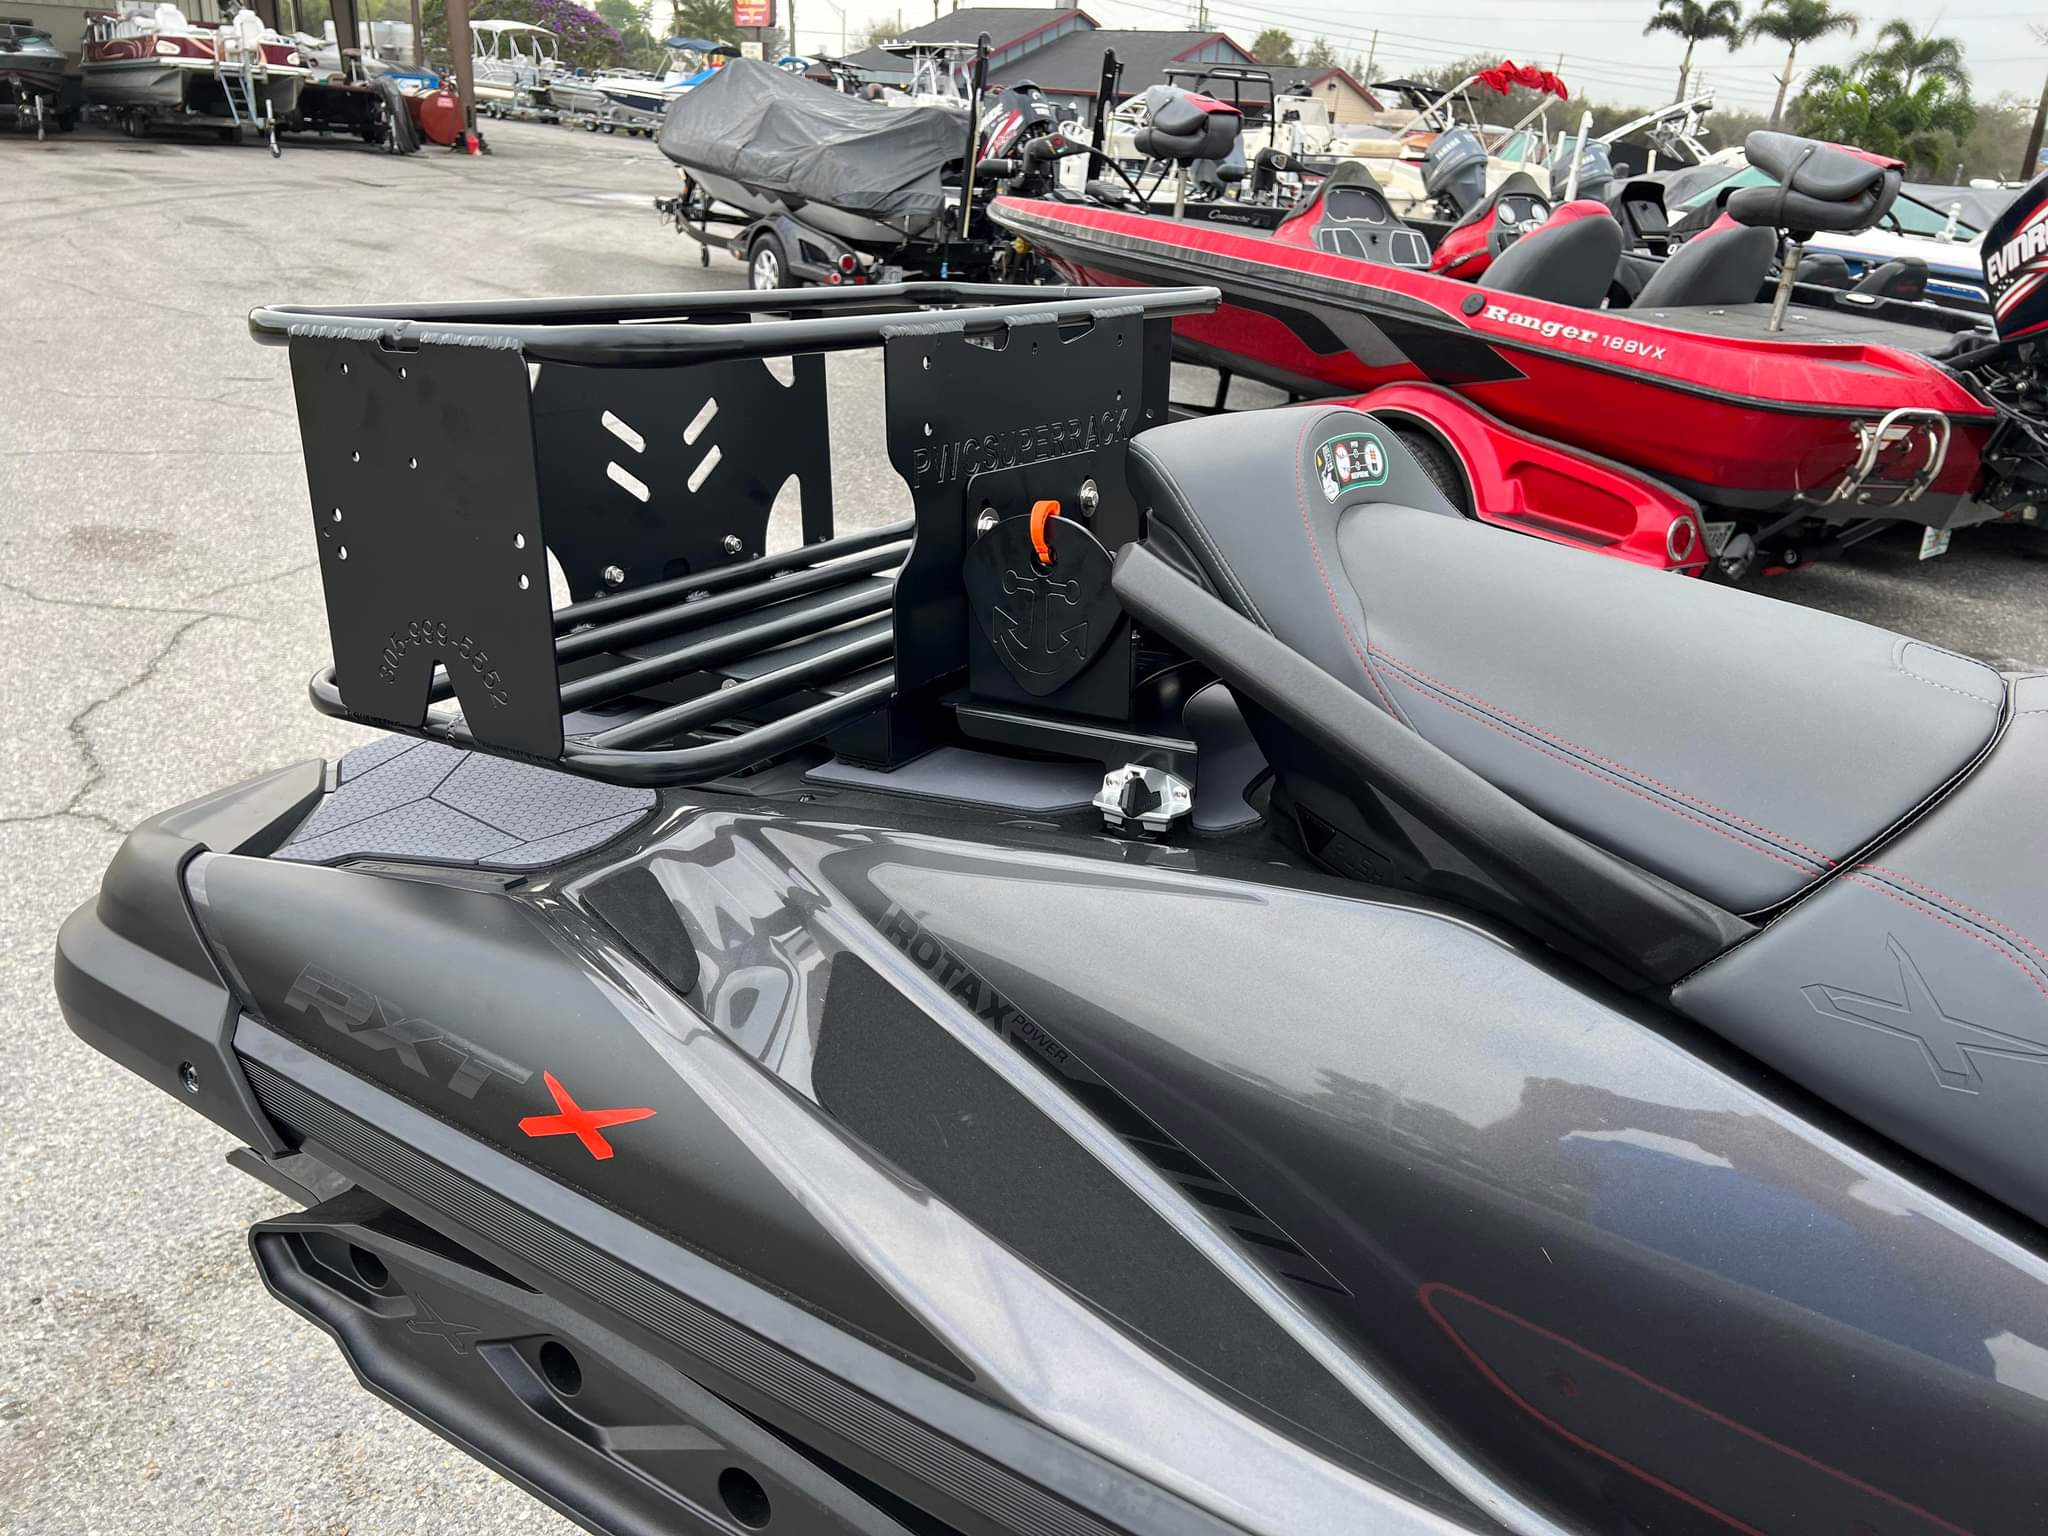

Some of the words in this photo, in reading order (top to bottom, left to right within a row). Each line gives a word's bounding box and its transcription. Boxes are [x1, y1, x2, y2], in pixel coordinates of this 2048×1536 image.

[1986, 218, 2048, 286] EVINR
[1483, 304, 1598, 343] Ranger
[1602, 334, 1667, 361] 188VX
[913, 408, 1130, 489] PWCSUPERRACK
[378, 619, 509, 709] 305-999-5552
[884, 907, 1015, 1035] ROTAX
[1012, 1014, 1070, 1064] POWER
[284, 961, 535, 1101] RXT
[518, 1070, 657, 1161] X
